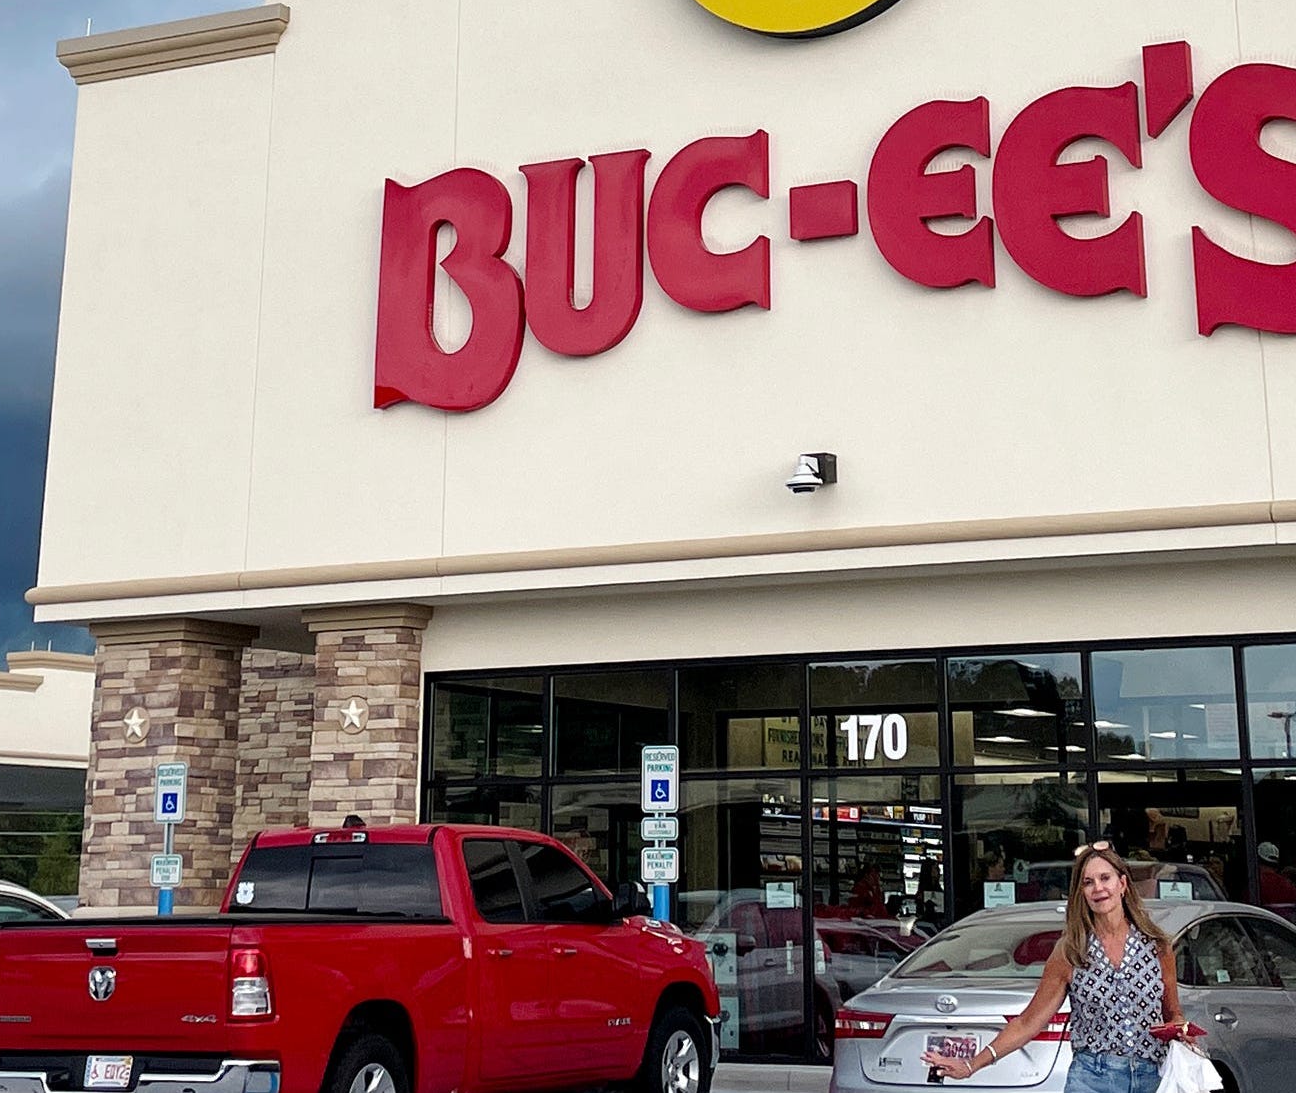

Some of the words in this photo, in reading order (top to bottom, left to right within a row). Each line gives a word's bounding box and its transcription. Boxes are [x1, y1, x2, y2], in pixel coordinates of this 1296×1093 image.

[840, 713, 908, 761] 170
[645, 752, 676, 761] RESERVED
[647, 764, 674, 772] PARKING
[647, 861, 673, 869] PENALTY
